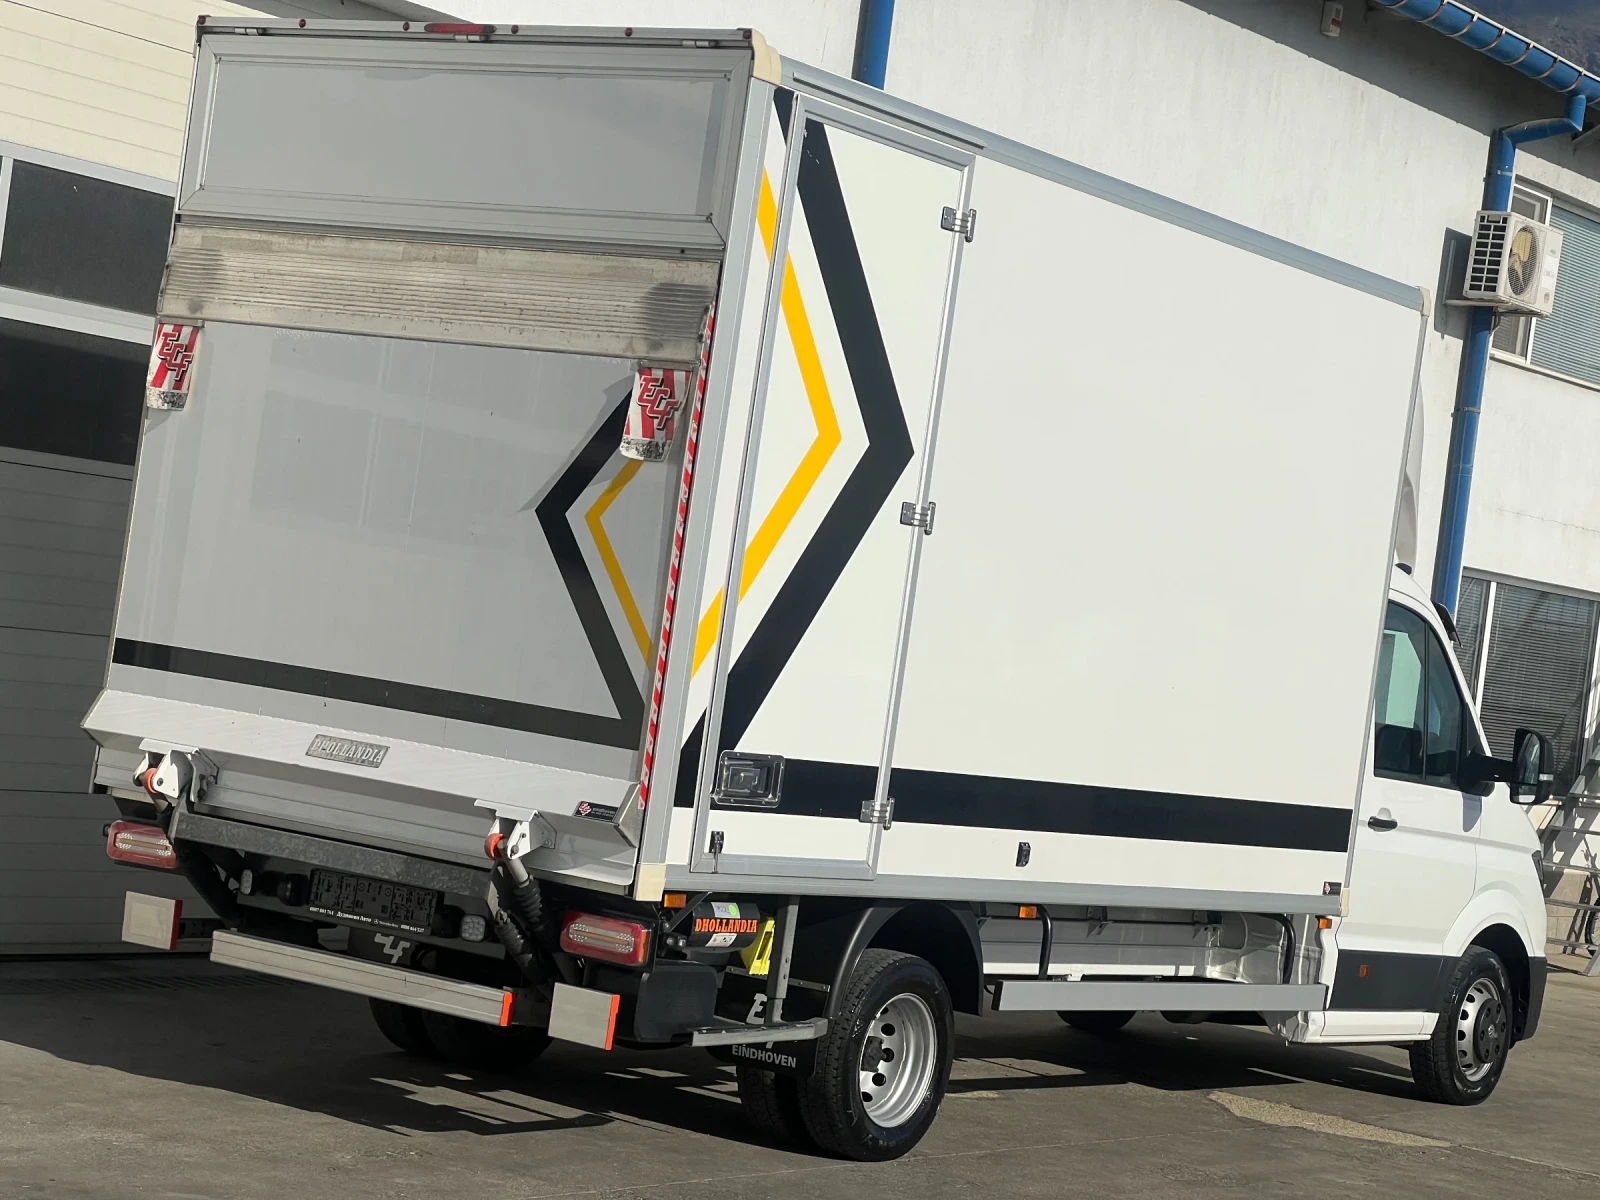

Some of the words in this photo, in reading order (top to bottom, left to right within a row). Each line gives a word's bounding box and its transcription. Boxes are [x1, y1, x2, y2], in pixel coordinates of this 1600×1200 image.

[311, 738, 386, 763] DHOLLANDIA
[694, 918, 758, 933] DHOLLANDIA
[732, 1044, 797, 1069] EINDHOVEN
